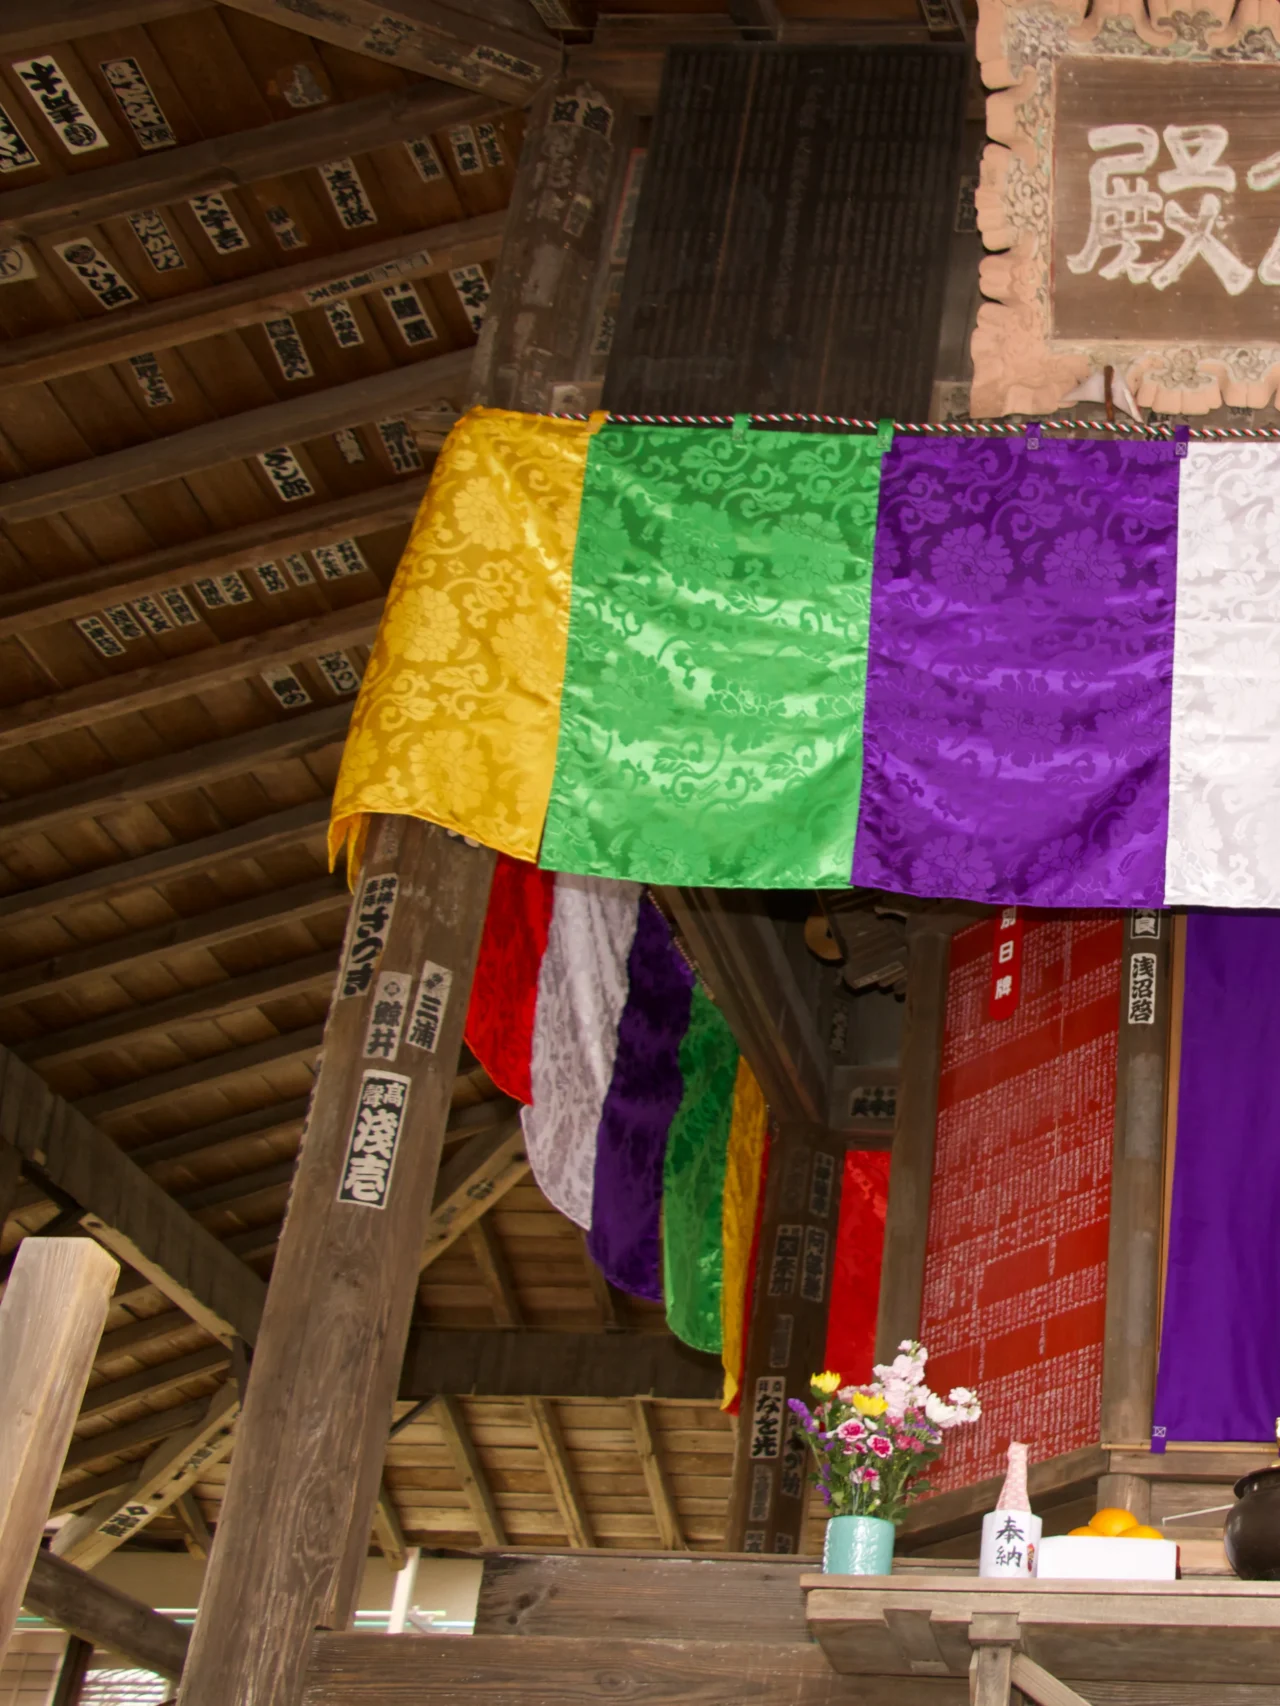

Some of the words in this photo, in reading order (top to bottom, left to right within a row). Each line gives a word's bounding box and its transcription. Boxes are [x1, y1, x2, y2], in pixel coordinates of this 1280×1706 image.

[1130, 955, 1155, 1022] 浅沼啓
[995, 1515, 1025, 1568] 奉納
